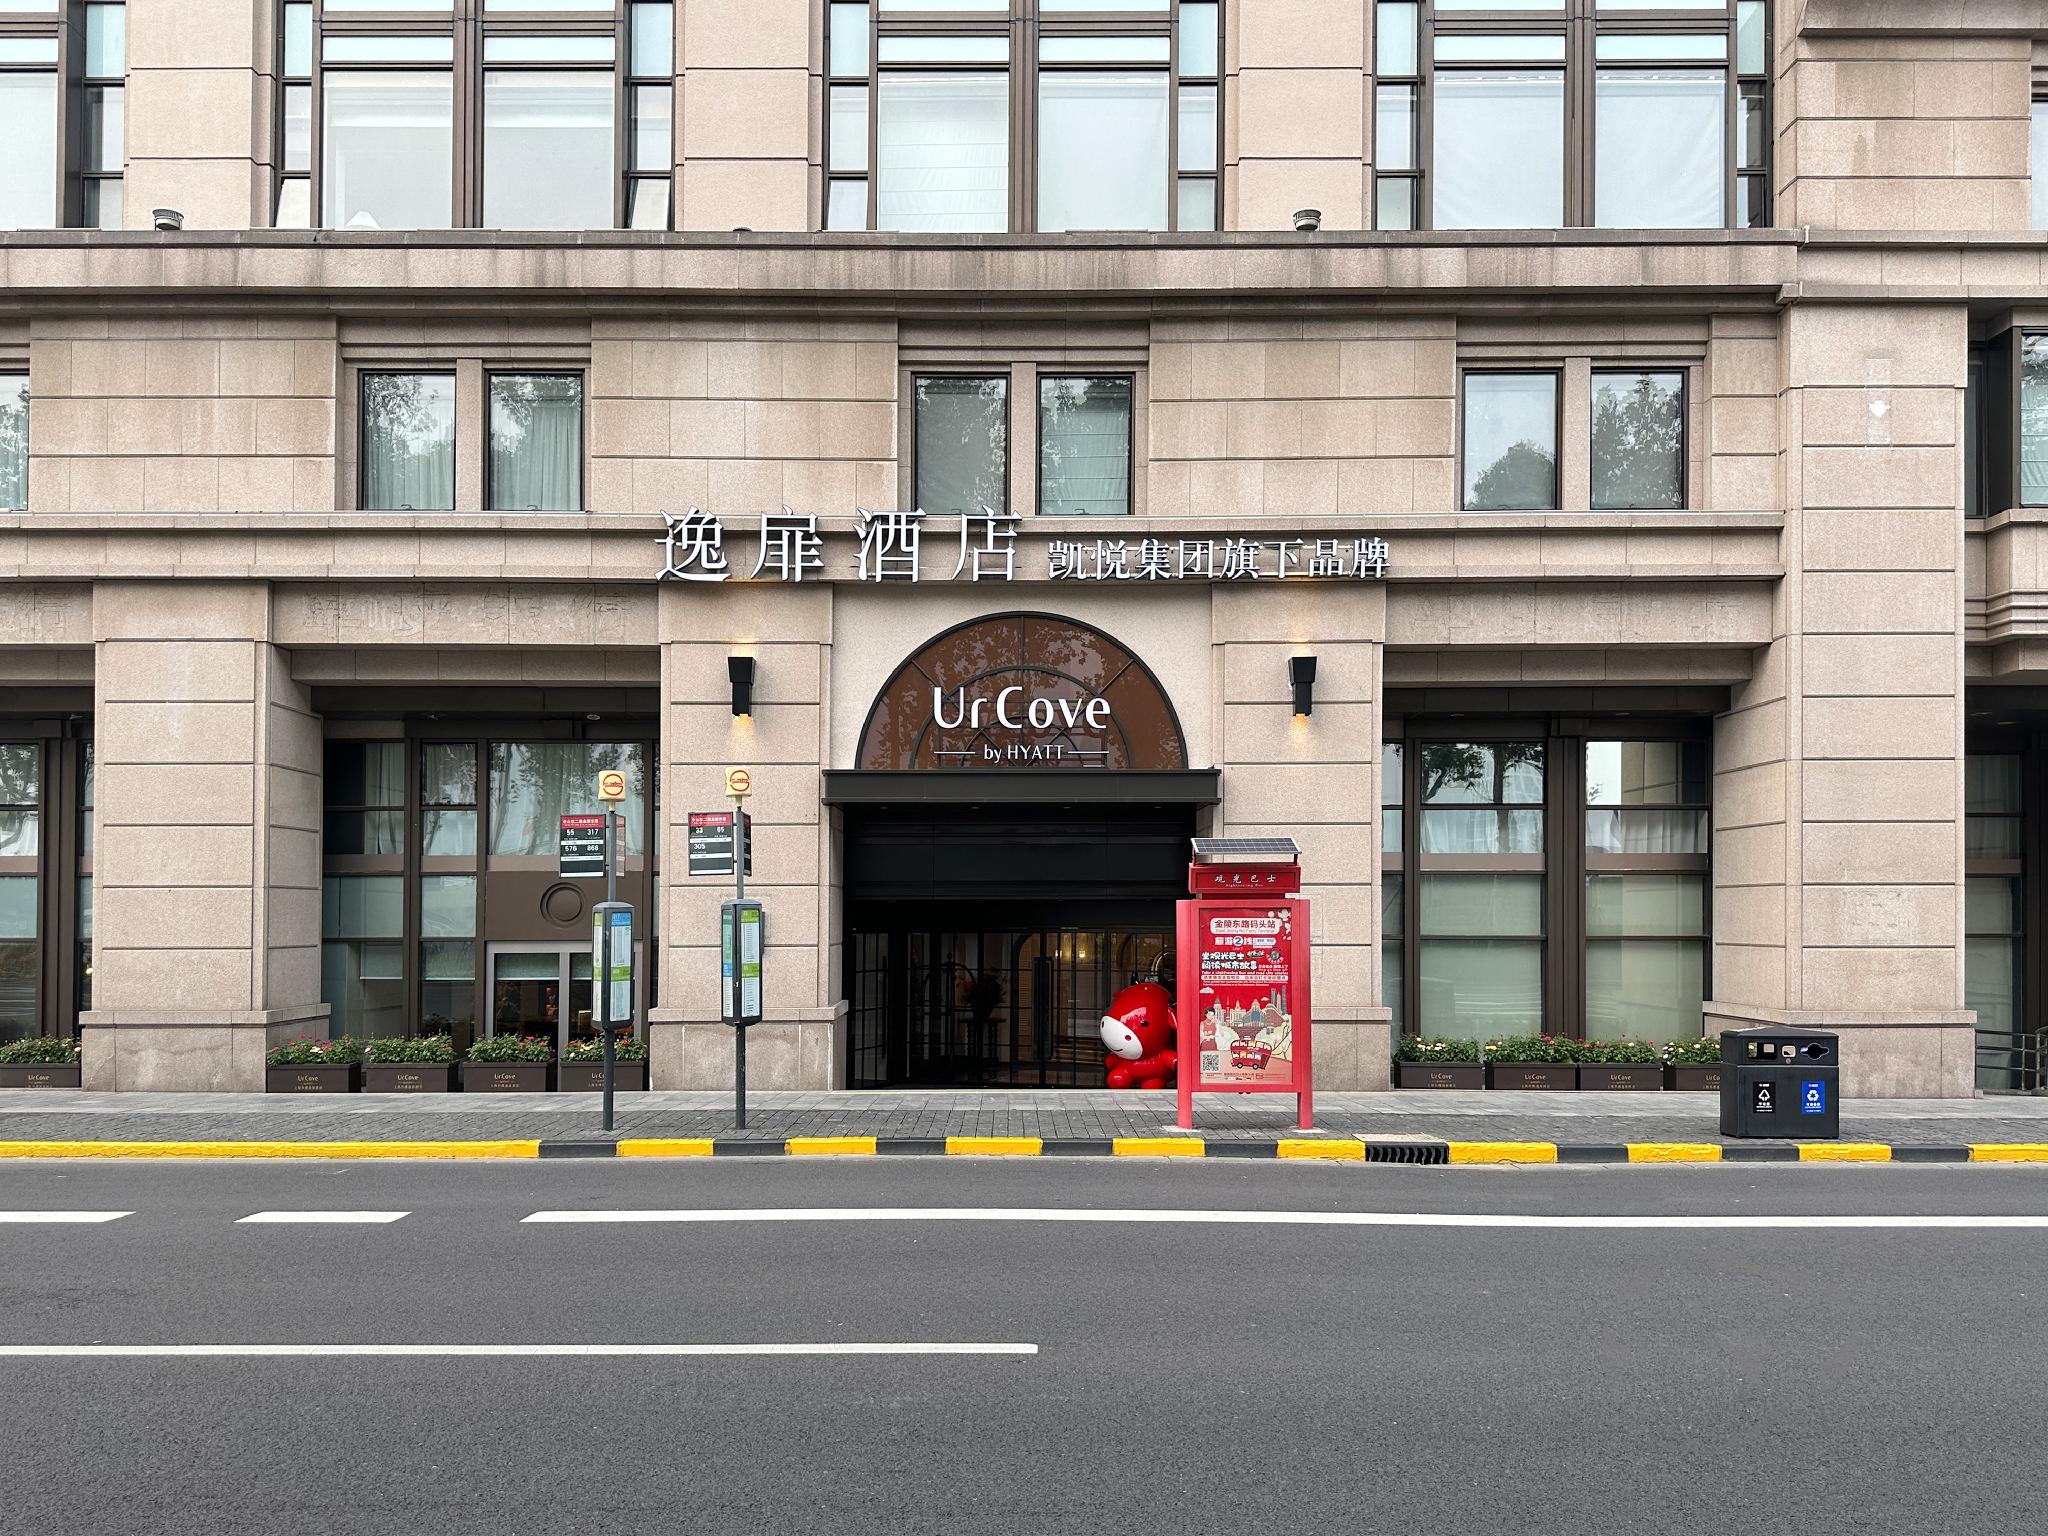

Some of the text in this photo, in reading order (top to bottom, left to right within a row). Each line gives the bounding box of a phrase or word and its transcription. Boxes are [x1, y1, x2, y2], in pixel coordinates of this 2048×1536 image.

[654, 504, 1022, 583] 逸扉酒店
[1048, 537, 1391, 580] 凯悦集团旗下品牌
[984, 745, 1064, 763] by HYATT
[566, 828, 599, 836] 55 317
[1214, 874, 1277, 884] 观光巴士
[1214, 920, 1276, 929] 金陵东路码头站
[1202, 960, 1257, 970] 阅读城市故事
